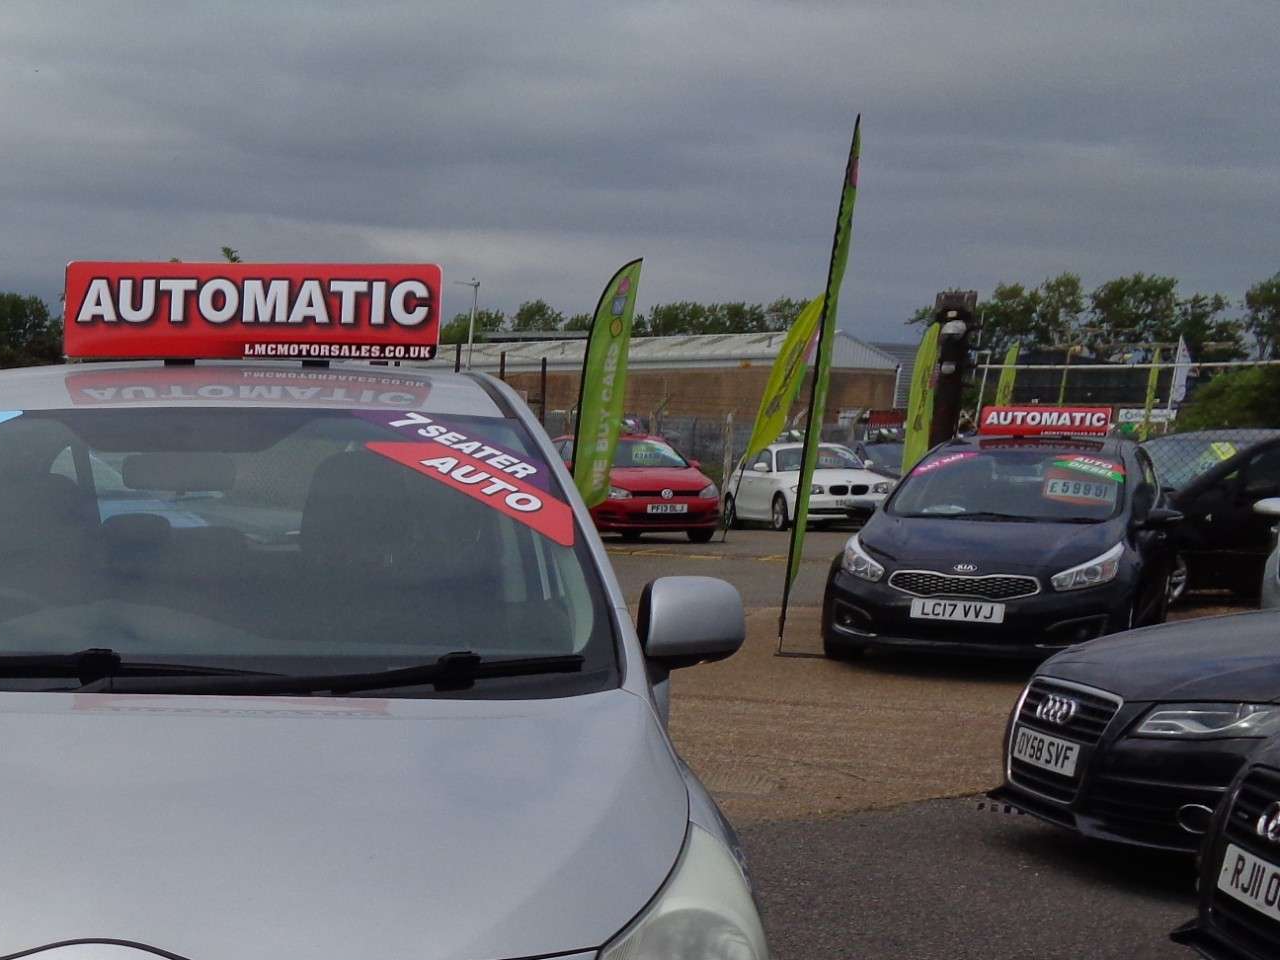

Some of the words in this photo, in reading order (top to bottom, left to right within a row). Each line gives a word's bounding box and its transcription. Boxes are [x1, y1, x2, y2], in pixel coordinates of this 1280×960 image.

[76, 278, 430, 326] AUTOMATIC
[243, 343, 432, 359] LMCMOTORSALES.CO.UK
[985, 411, 1106, 427] AUTOMATIC
[388, 412, 433, 430] 7
[417, 425, 539, 479] SEATER
[1073, 456, 1113, 469] AUTO
[420, 456, 544, 512] AUTO
[955, 563, 975, 571] KIA
[921, 602, 957, 618] LC17
[963, 604, 995, 620] VVJ
[1045, 741, 1074, 769] SVF
